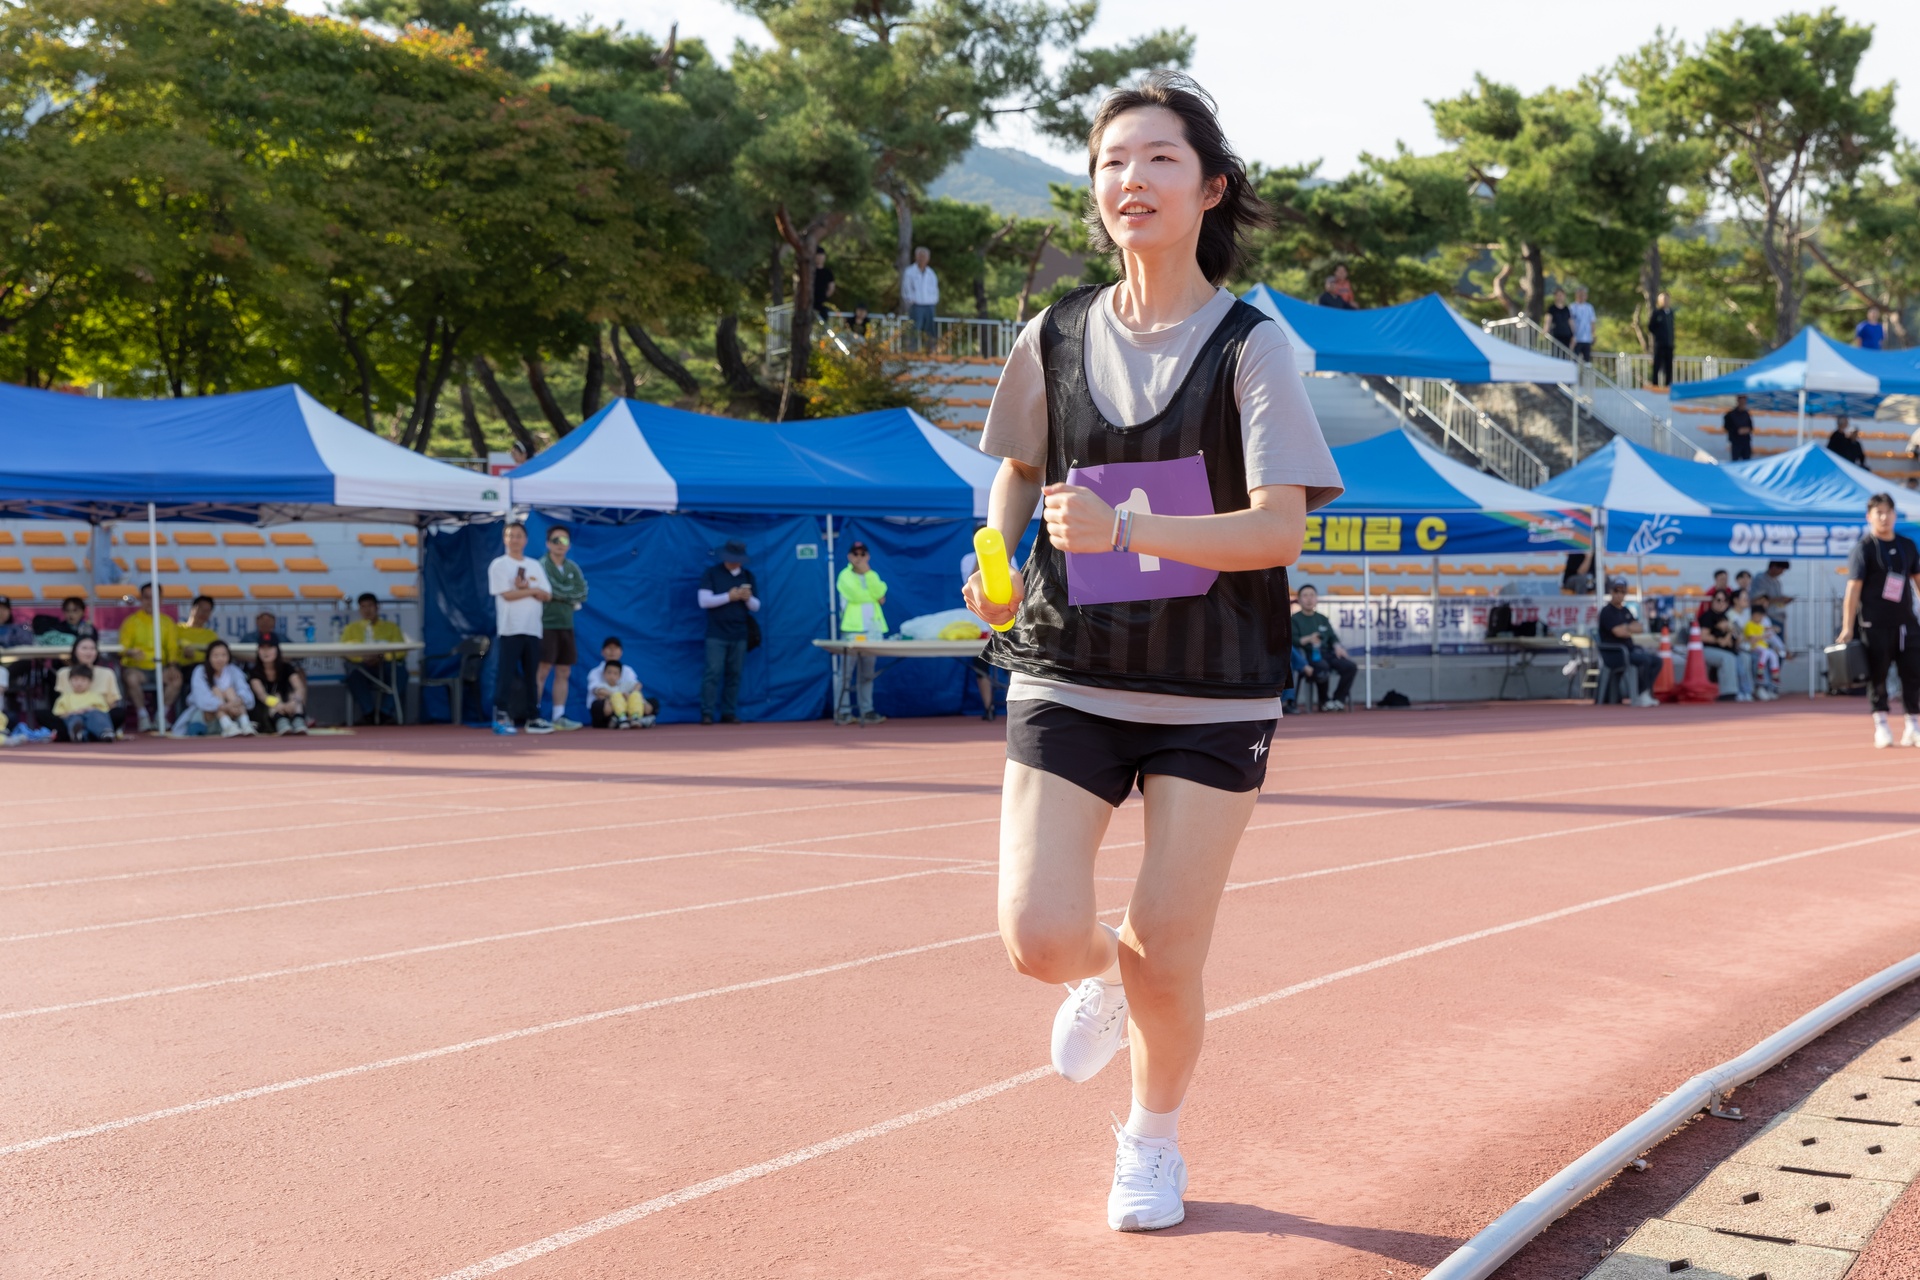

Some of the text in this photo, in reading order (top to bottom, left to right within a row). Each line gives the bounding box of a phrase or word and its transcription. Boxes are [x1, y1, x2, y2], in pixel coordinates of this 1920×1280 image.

[1415, 516, 1448, 551] C
[1729, 522, 1872, 557] 이벤트업
[1472, 607, 1540, 628] 국대표
